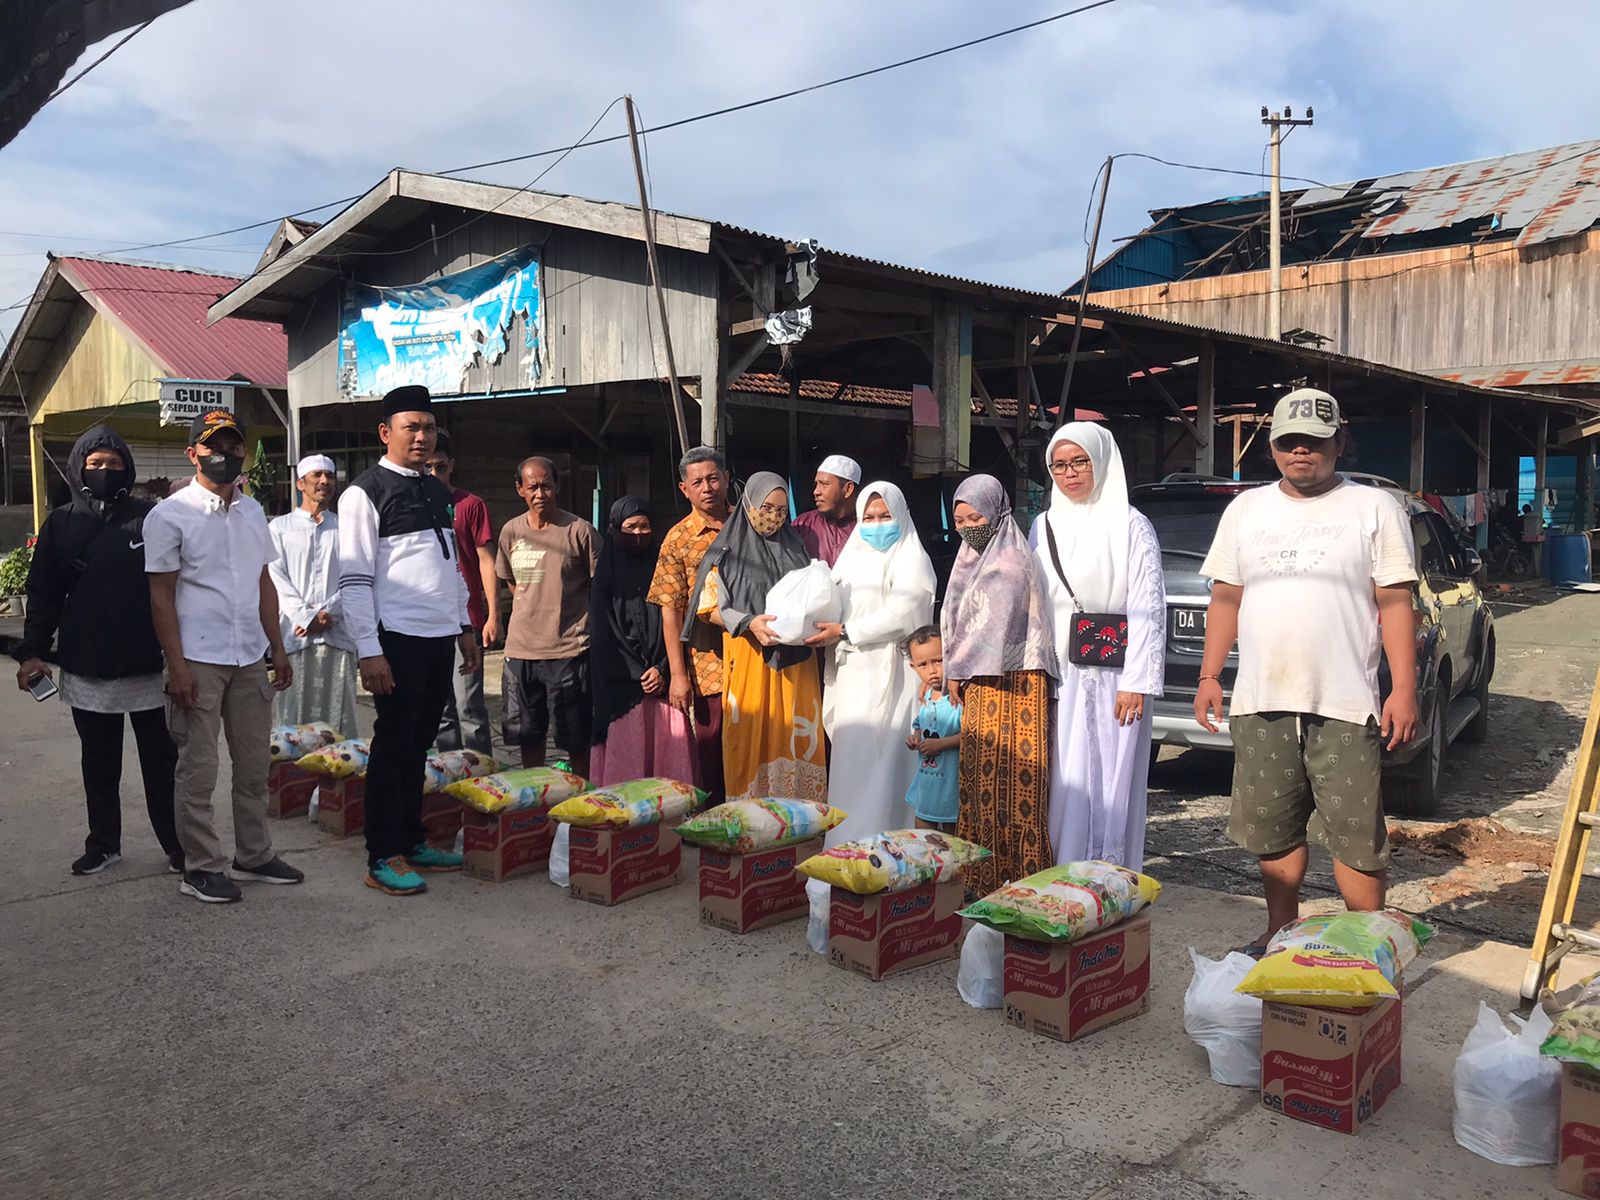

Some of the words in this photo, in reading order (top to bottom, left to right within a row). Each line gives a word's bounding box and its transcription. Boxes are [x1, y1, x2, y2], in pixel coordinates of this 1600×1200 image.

[175, 389, 222, 404] CUCI
[168, 403, 199, 413] SEPEDA
[1289, 399, 1313, 420] 73
[1280, 549, 1298, 559] CR
[1178, 611, 1195, 628] DA
